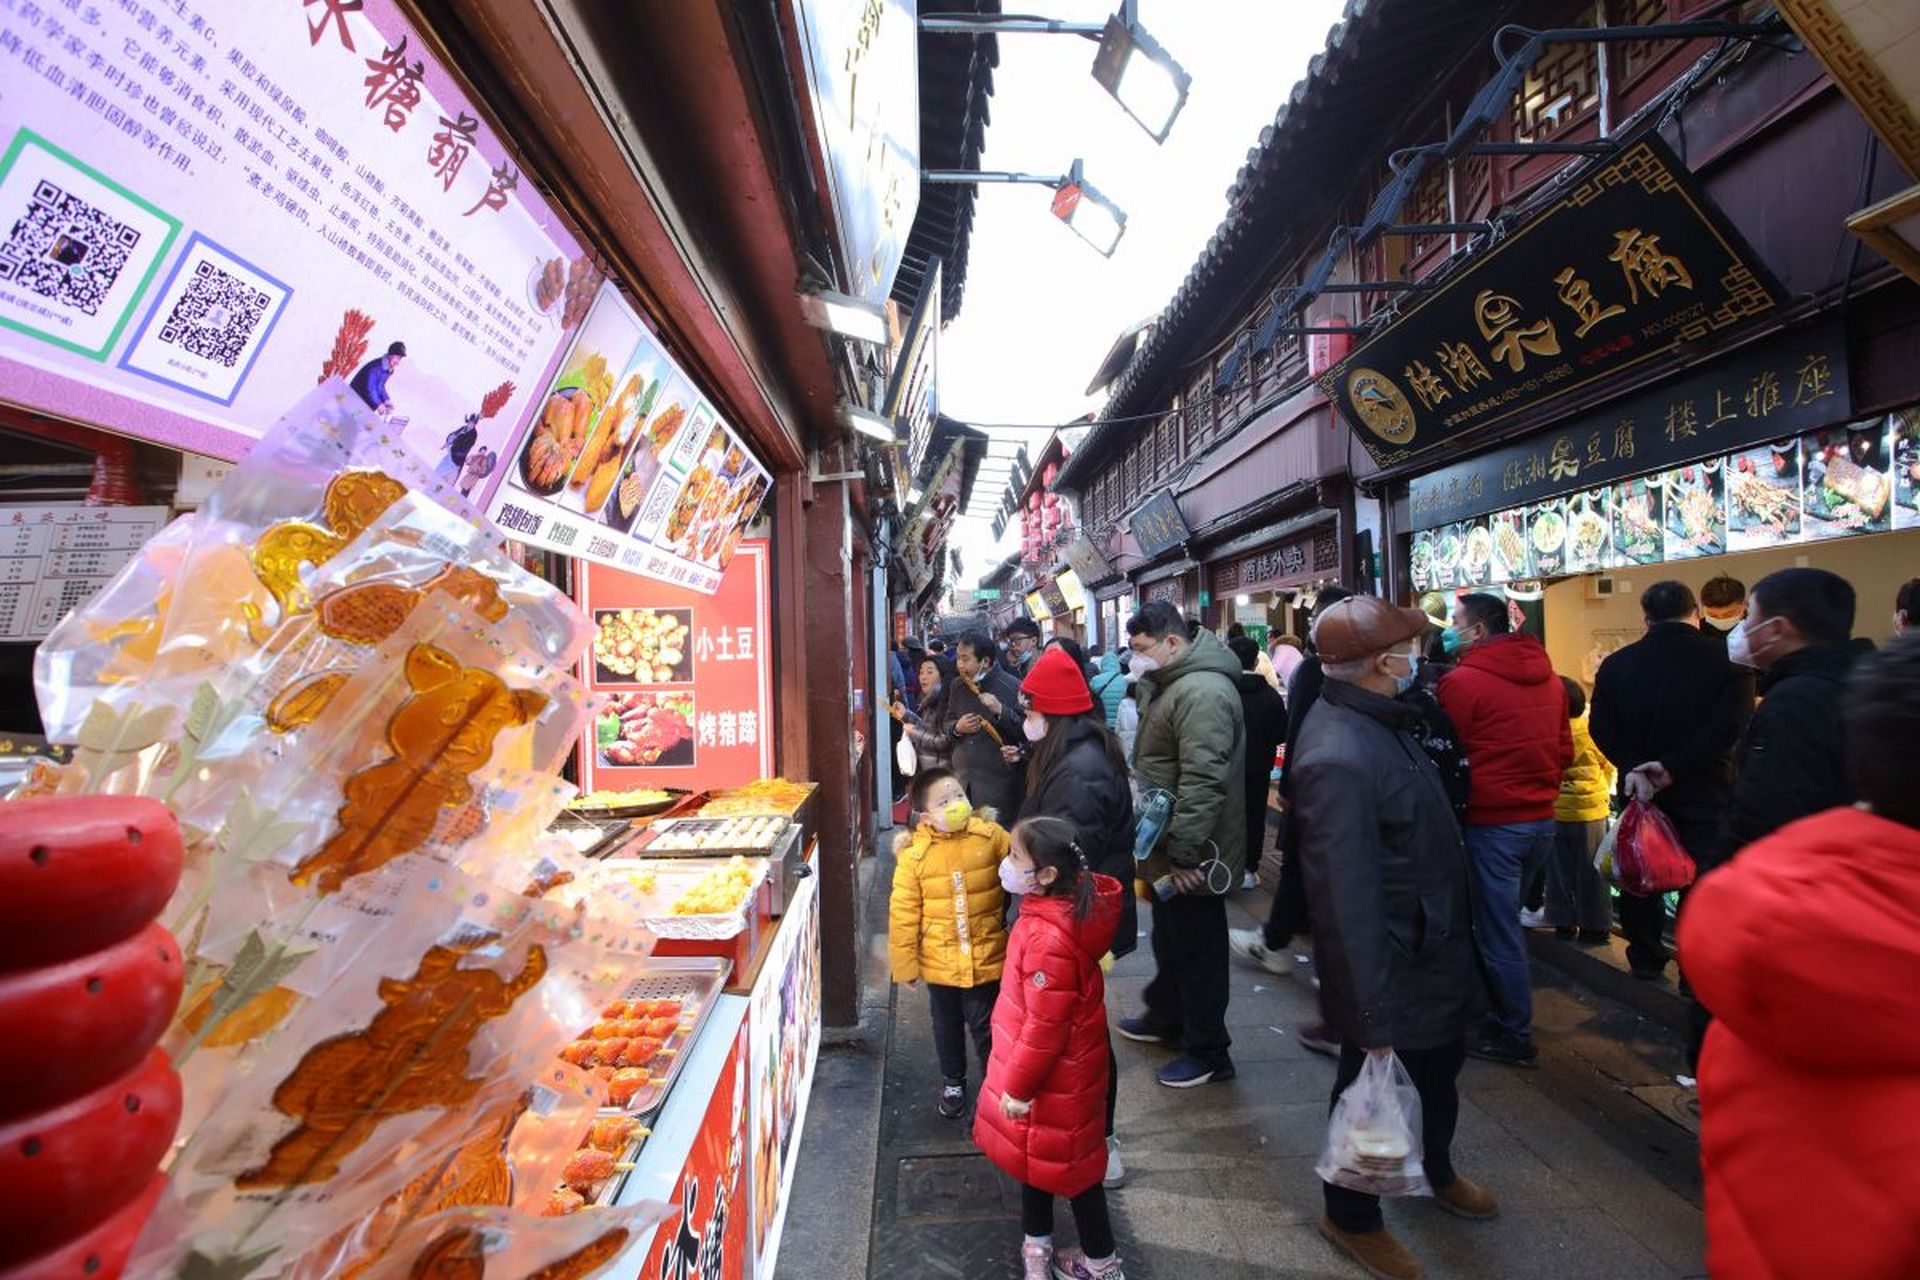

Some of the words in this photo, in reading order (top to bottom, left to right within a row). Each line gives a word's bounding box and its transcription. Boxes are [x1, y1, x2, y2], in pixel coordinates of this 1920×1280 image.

[1664, 354, 1836, 442] 楼上雅座
[1243, 545, 1306, 584] 酒楼外卖
[695, 625, 754, 663] 小土豆
[697, 709, 758, 748] 烤猪蹄
